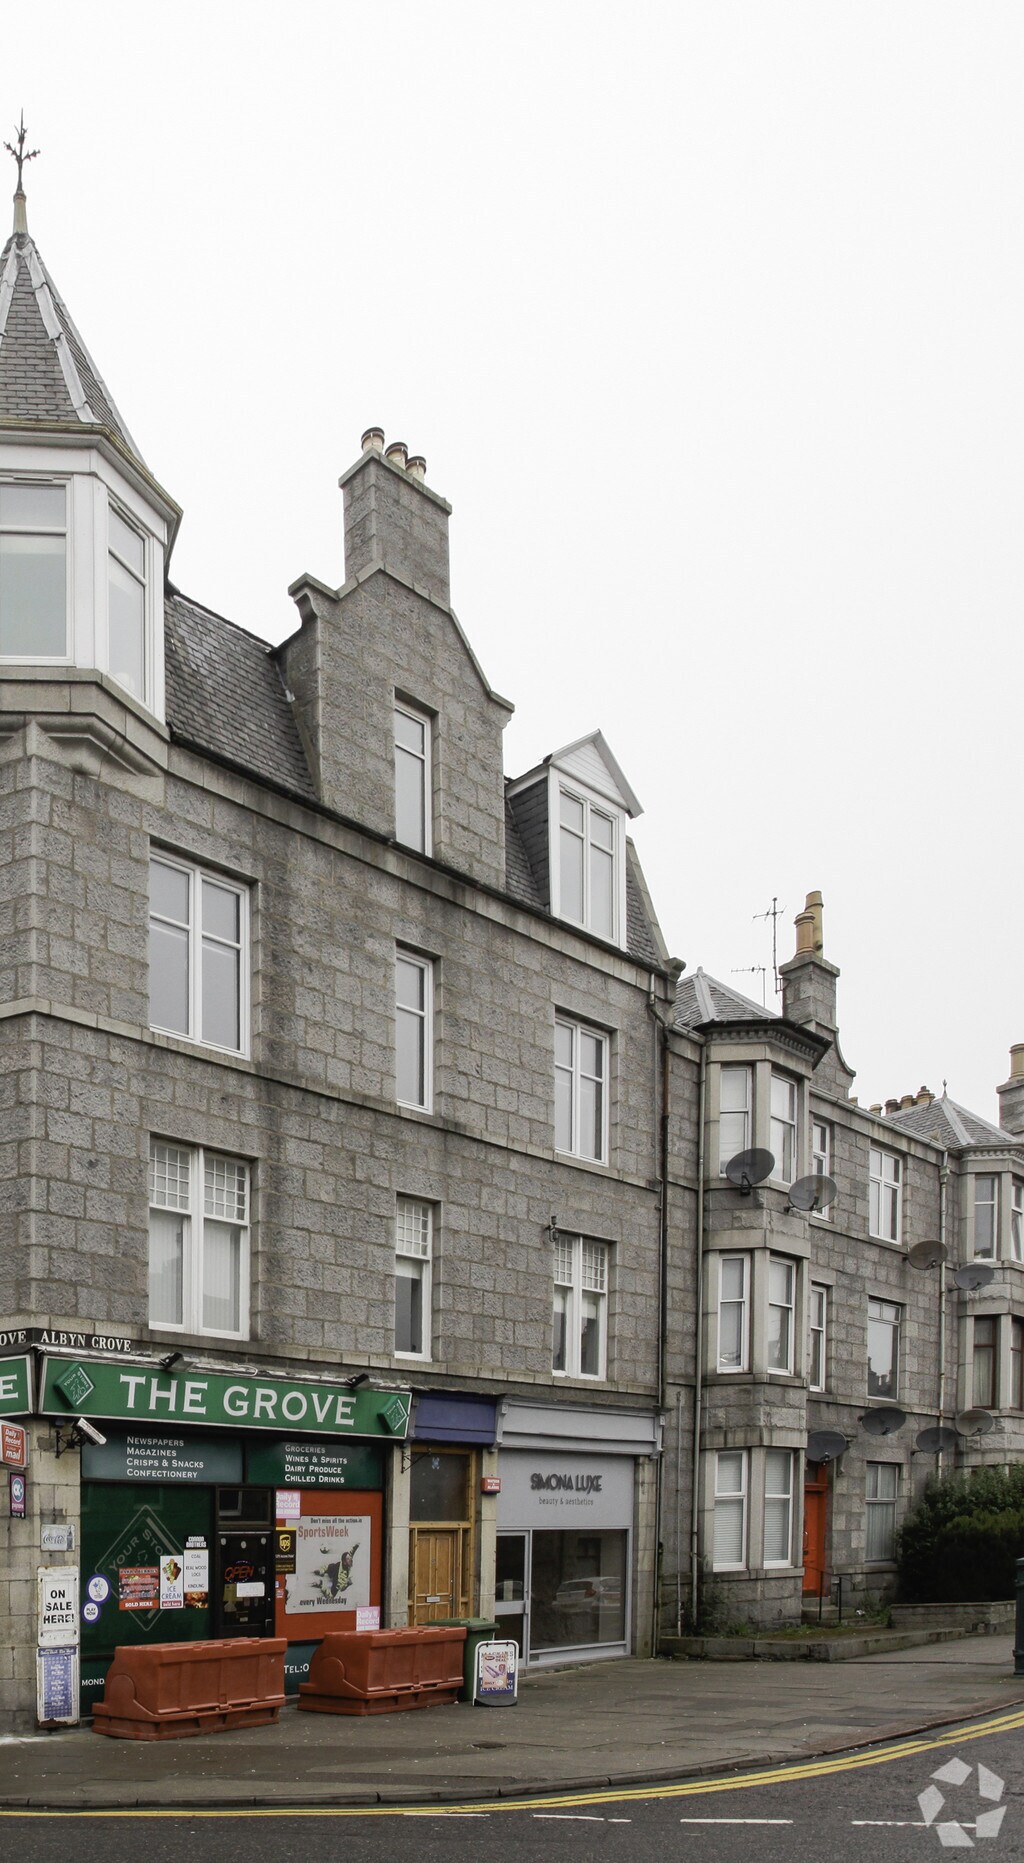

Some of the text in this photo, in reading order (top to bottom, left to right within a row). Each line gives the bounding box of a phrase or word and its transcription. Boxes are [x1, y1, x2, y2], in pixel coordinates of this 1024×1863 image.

[40, 1331, 131, 1352] ALBYN GROVE
[120, 1374, 356, 1426] THE GROVE
[6, 1429, 17, 1438] Daily
[5, 1436, 22, 1446] Record
[127, 1436, 184, 1447] NEWSPAPERS
[6, 1448, 20, 1460] mail
[127, 1447, 176, 1456] MAGAZINES
[285, 1444, 326, 1454] GROCERIES
[127, 1458, 204, 1468] CRISPS & SNACKS
[286, 1454, 309, 1463] WINES
[320, 1456, 348, 1464] SPIRITS
[127, 1468, 198, 1478] CONFECTIONERY
[285, 1464, 342, 1474] DAIRY PRODUCE
[285, 1474, 344, 1484] CHILLED DRINKS
[530, 1472, 602, 1494] SIMONA LUXE
[538, 1497, 558, 1506] beauty
[565, 1498, 594, 1506] aesthetics
[298, 1526, 349, 1540] SportsWeek
[142, 1529, 167, 1556] STO
[108, 1536, 140, 1570] YOUR
[224, 1566, 254, 1580] OPEN
[50, 1590, 65, 1598] ON
[46, 1602, 72, 1611] SALE
[300, 1596, 347, 1607] every Wednesday
[44, 1614, 74, 1624] HERE!
[358, 1610, 371, 1618] Daily
[284, 1663, 309, 1674] TEL:0
[82, 1678, 105, 1686] MOND
